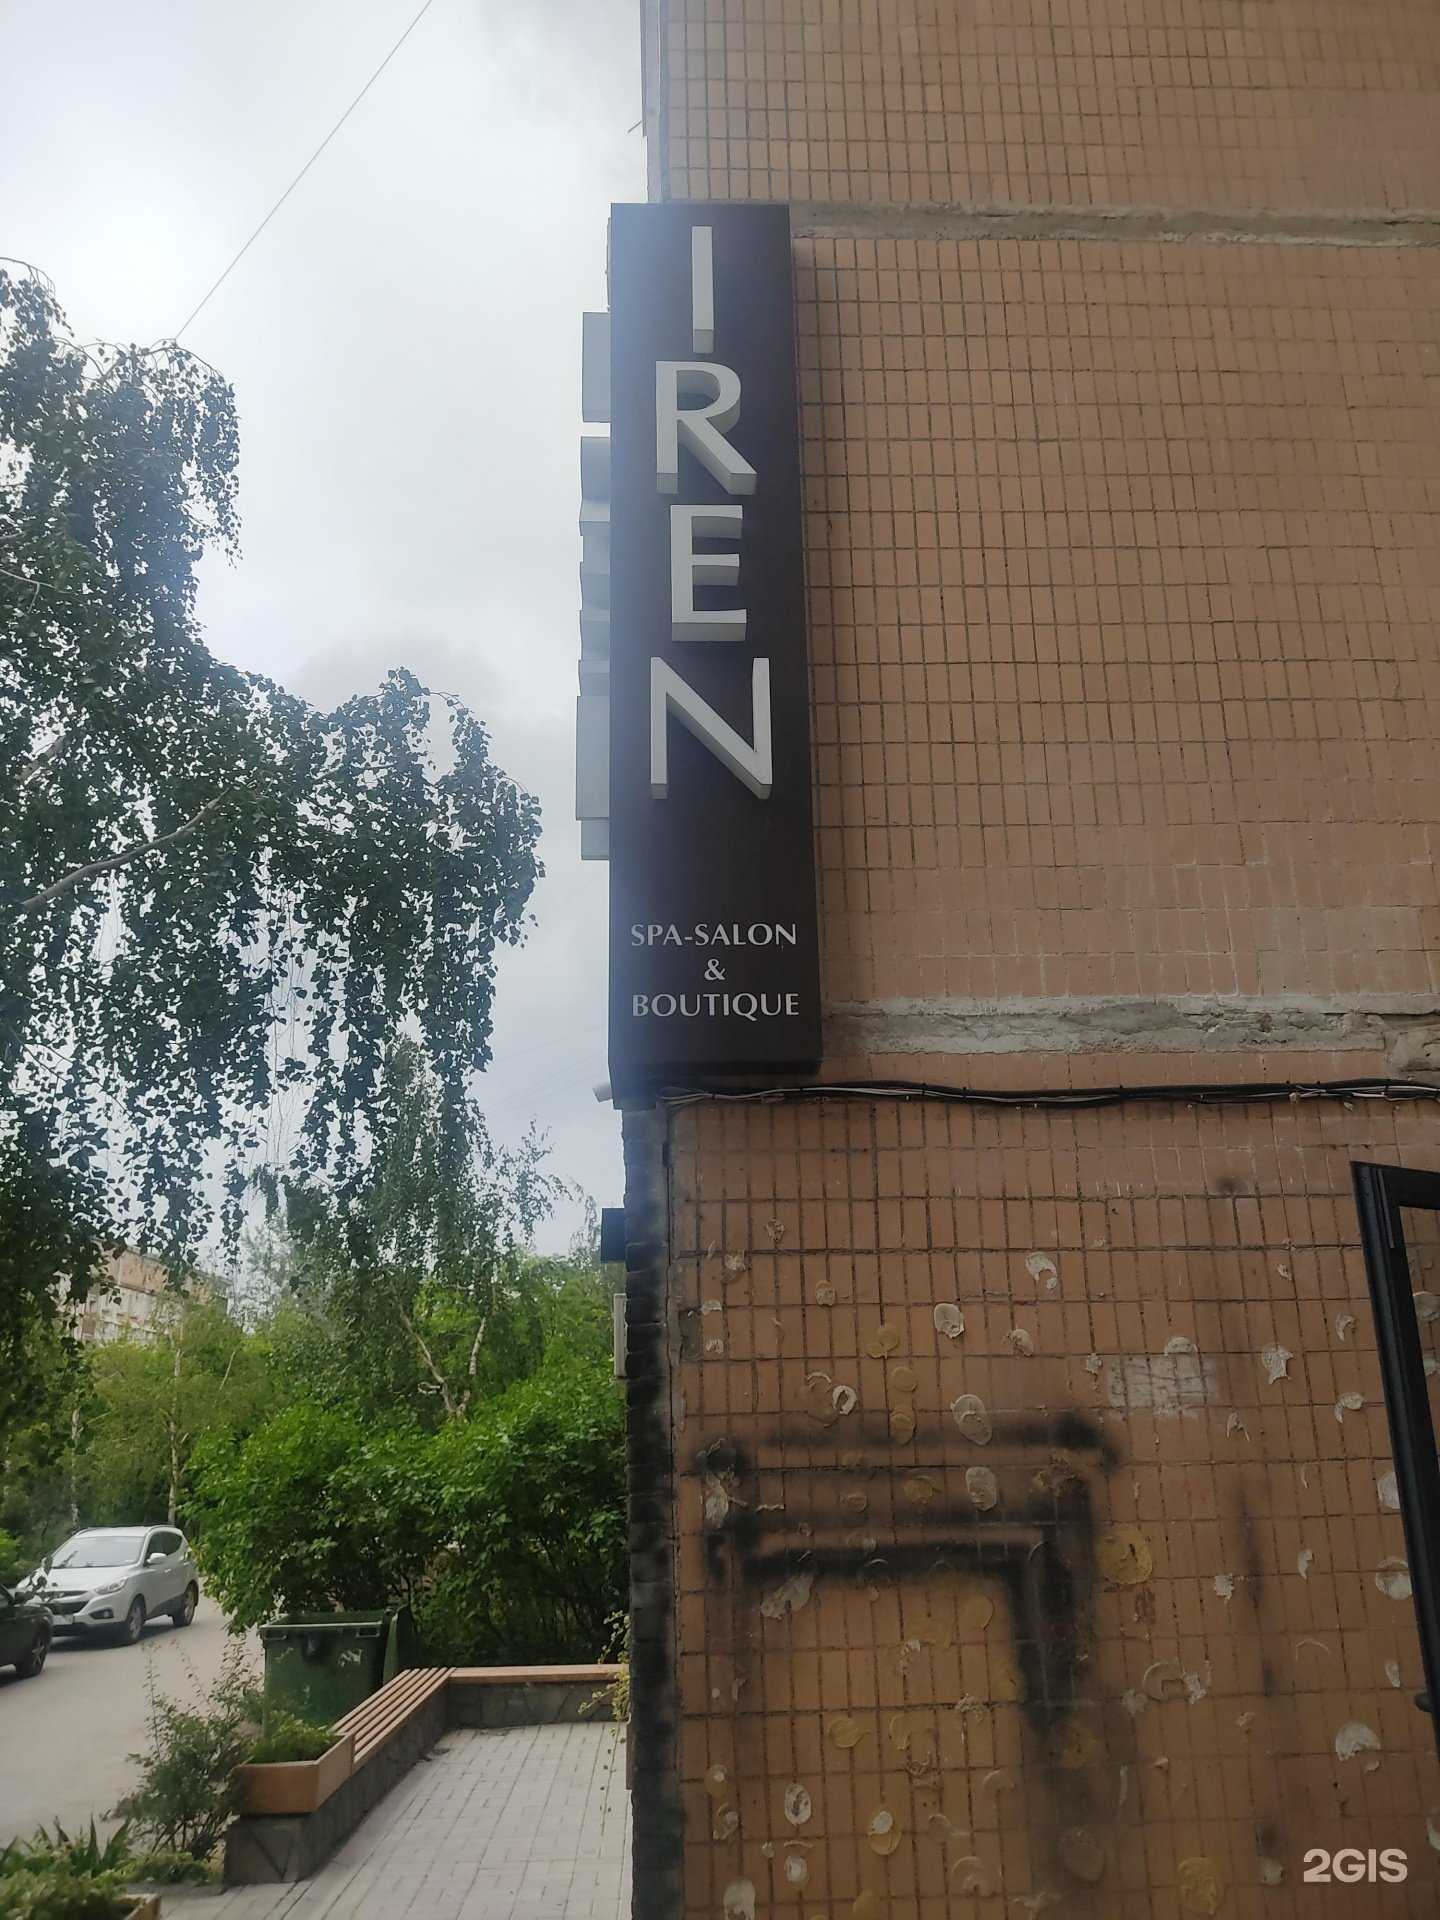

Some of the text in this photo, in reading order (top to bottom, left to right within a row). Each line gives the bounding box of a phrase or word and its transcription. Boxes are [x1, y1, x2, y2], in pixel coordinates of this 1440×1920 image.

[650, 226, 773, 799] IREN
[630, 923, 797, 947] SPA-SALON
[703, 958, 726, 981] &
[632, 993, 800, 1021] BOUTIQUE
